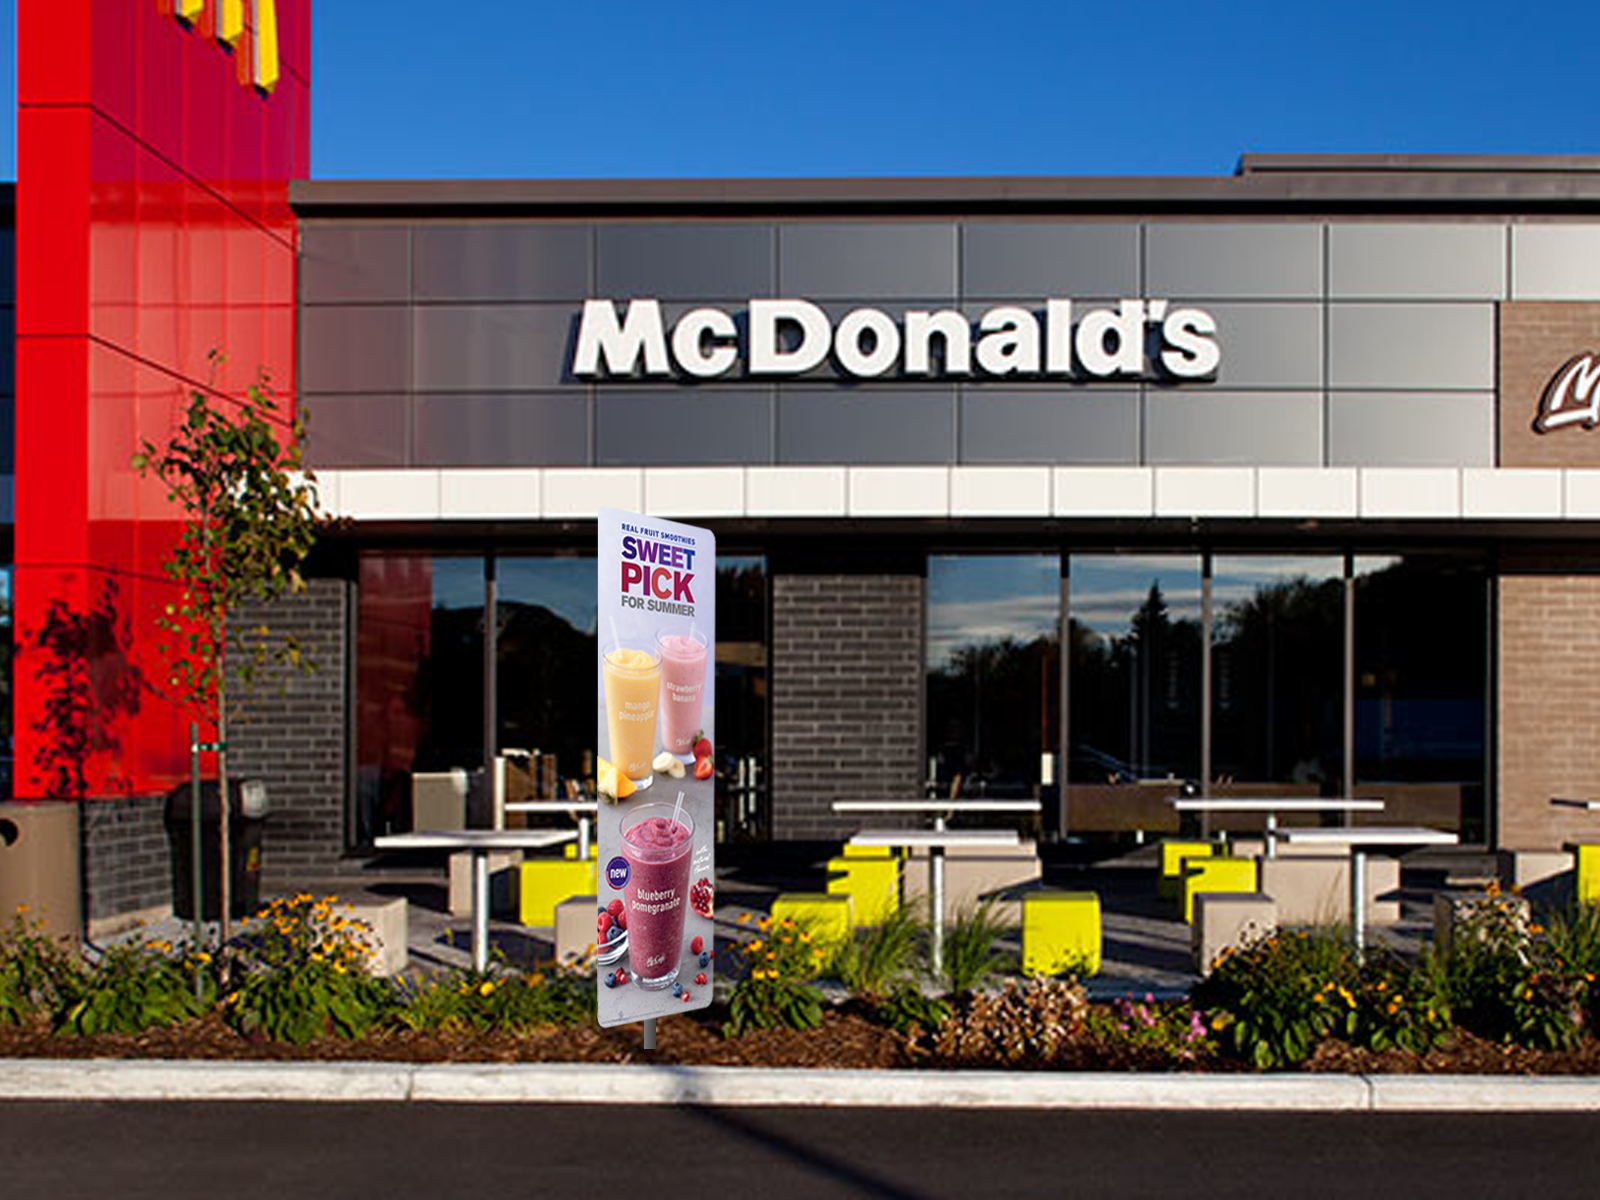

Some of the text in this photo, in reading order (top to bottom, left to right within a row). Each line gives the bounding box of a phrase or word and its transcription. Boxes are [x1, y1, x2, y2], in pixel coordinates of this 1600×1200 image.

[573, 299, 1221, 379] McDonald's
[621, 523, 696, 546] REAL FRUIT SMOOTHIES
[621, 535, 696, 570] SWEET
[621, 561, 695, 604] PICK
[621, 595, 695, 617] FOR SUMMER
[666, 681, 702, 693] strawberry
[672, 692, 696, 702] banana
[625, 700, 650, 712] mango
[619, 710, 654, 723] pineapple
[610, 867, 627, 879] new
[637, 888, 675, 901] blueberry
[632, 897, 681, 915] pomegranate
